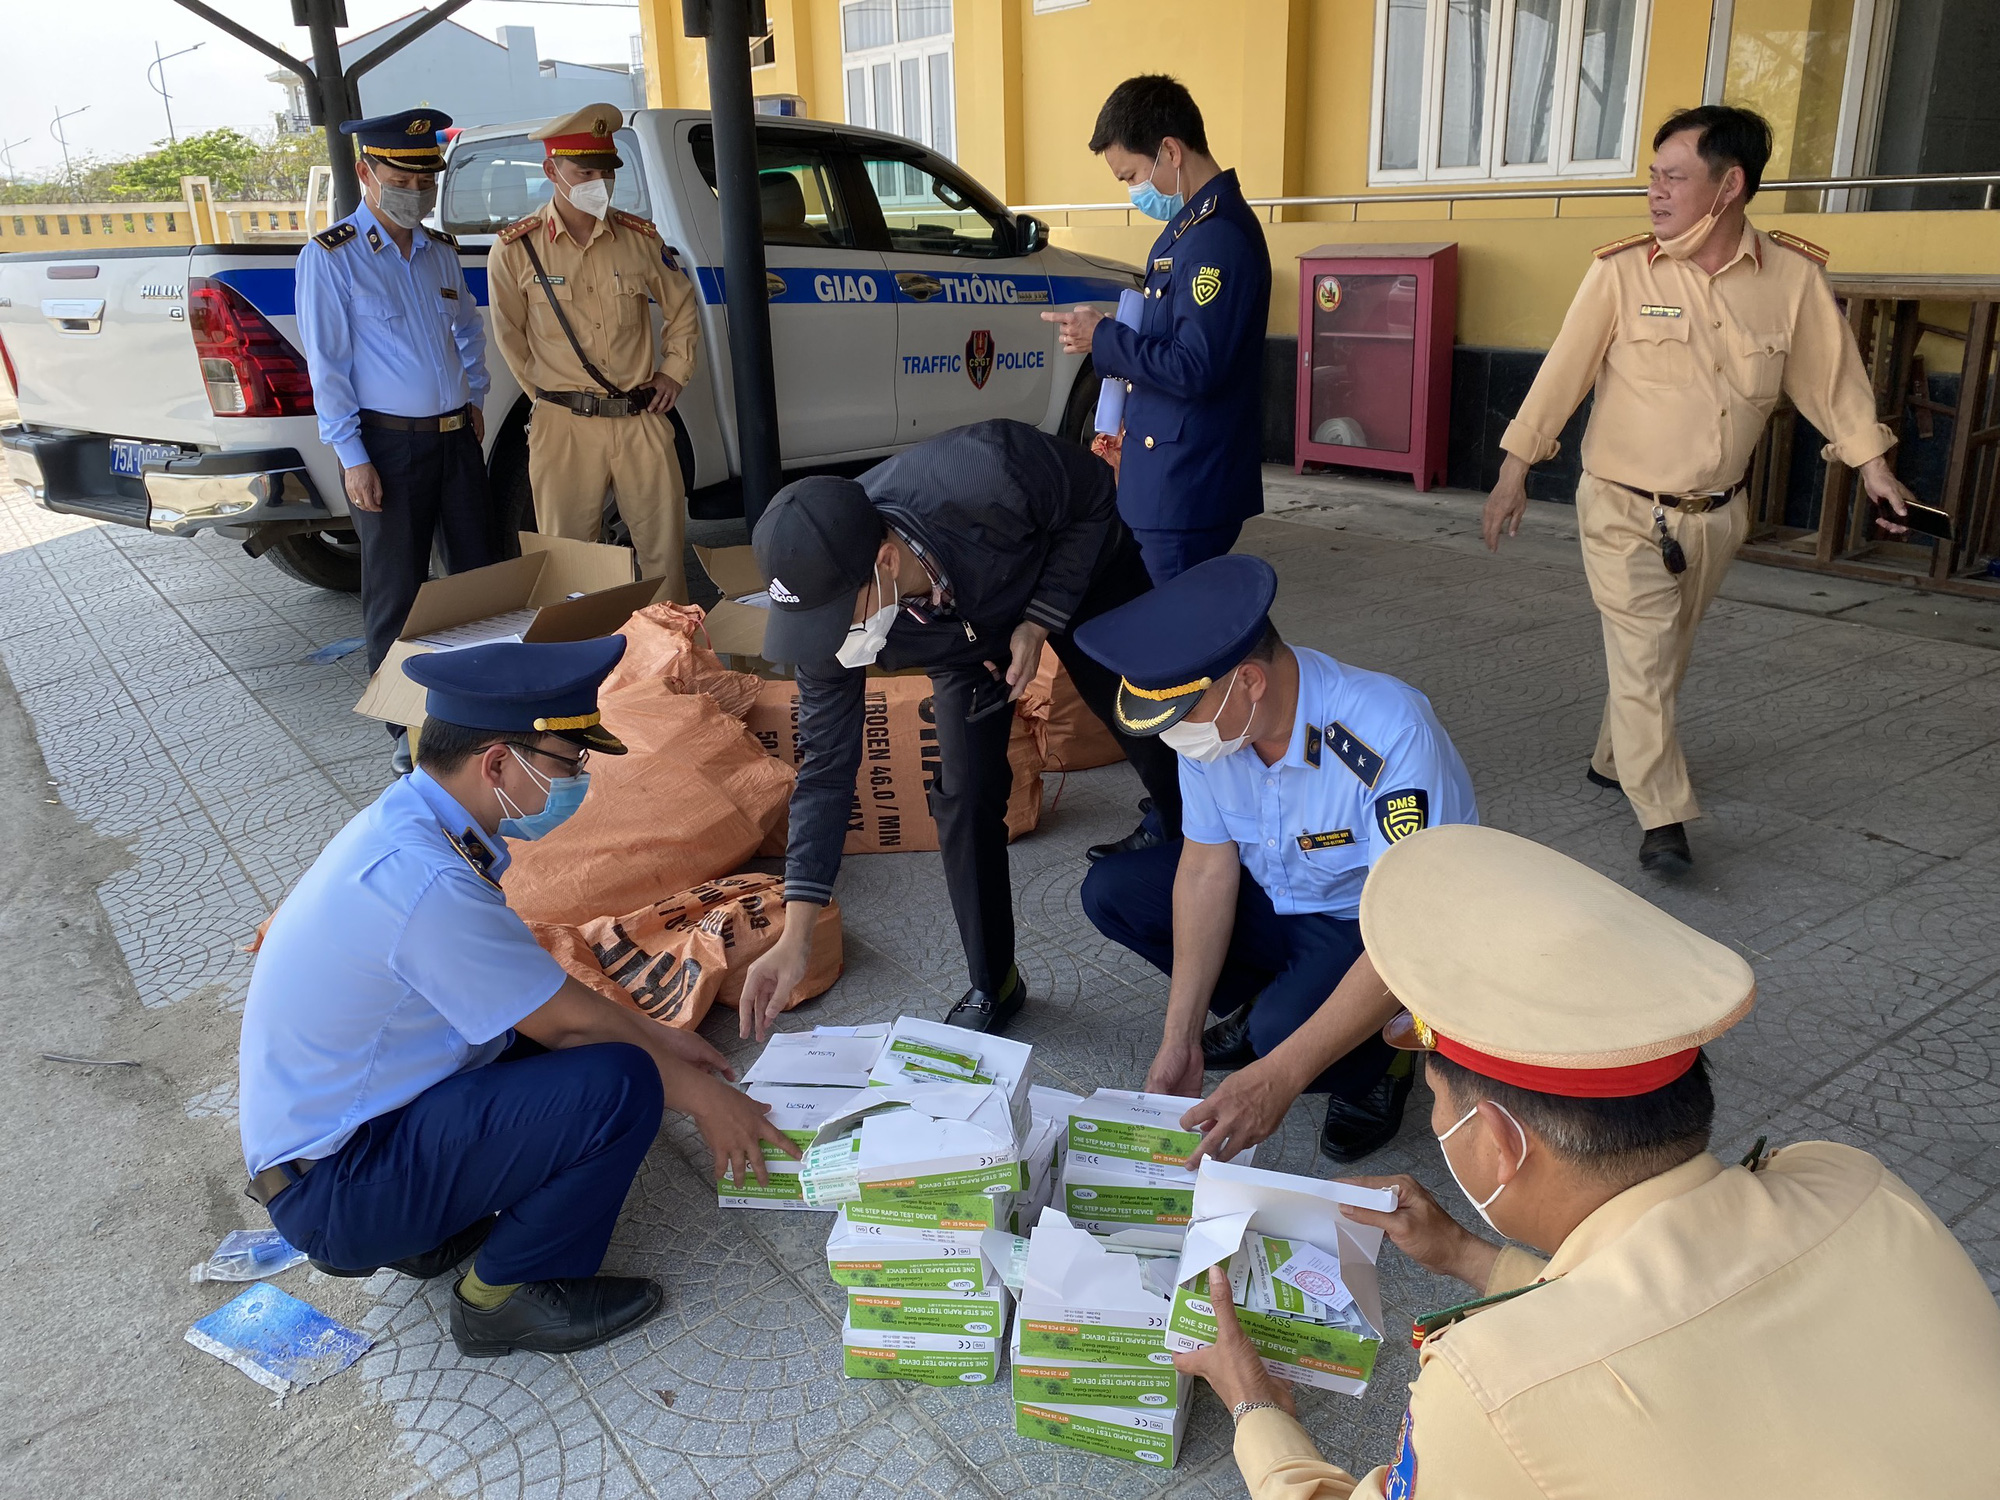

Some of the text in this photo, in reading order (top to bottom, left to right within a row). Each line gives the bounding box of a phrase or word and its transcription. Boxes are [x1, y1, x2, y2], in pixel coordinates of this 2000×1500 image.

[1200, 266, 1220, 278] DMS
[140, 284, 184, 300] HILUX
[814, 274, 878, 302] GIAO
[940, 274, 1018, 304] THÔNG
[902, 352, 1044, 374] TRAFFIC POLICE
[865, 690, 890, 761] NITROGEN
[870, 765, 896, 800] 46.0
[1387, 795, 1417, 812] DMS
[878, 814, 901, 848] MIN
[1116, 1142, 1129, 1150] TEST
[1130, 1145, 1150, 1153] DEVICE
[980, 1156, 993, 1165] CE
[1087, 1155, 1098, 1164] CE
[869, 1226, 880, 1234] CE
[943, 1247, 955, 1255] CE
[1148, 1317, 1162, 1327] CE
[1264, 1313, 1291, 1328] PASS
[1081, 1333, 1105, 1341] DEVICE
[1178, 1315, 1196, 1326] ONE
[1197, 1321, 1218, 1333] STEP
[1267, 1342, 1297, 1354] DEVICE
[1251, 1321, 1275, 1333] Antigen
[1276, 1328, 1295, 1338] Rapid
[1310, 1336, 1331, 1345] Device
[958, 1340, 970, 1349] CE
[1180, 1339, 1191, 1347] IVD
[1314, 1360, 1322, 1368] 25
[1323, 1362, 1336, 1371] PCS
[1337, 1366, 1360, 1376] Devices
[1115, 1378, 1135, 1386] RAPID
[1134, 1417, 1147, 1427] CE
[1072, 1424, 1094, 1432] DEVICE
[1096, 1428, 1111, 1436] TEST
[1113, 1432, 1132, 1440] RAPID
[1134, 1436, 1149, 1444] STEP
